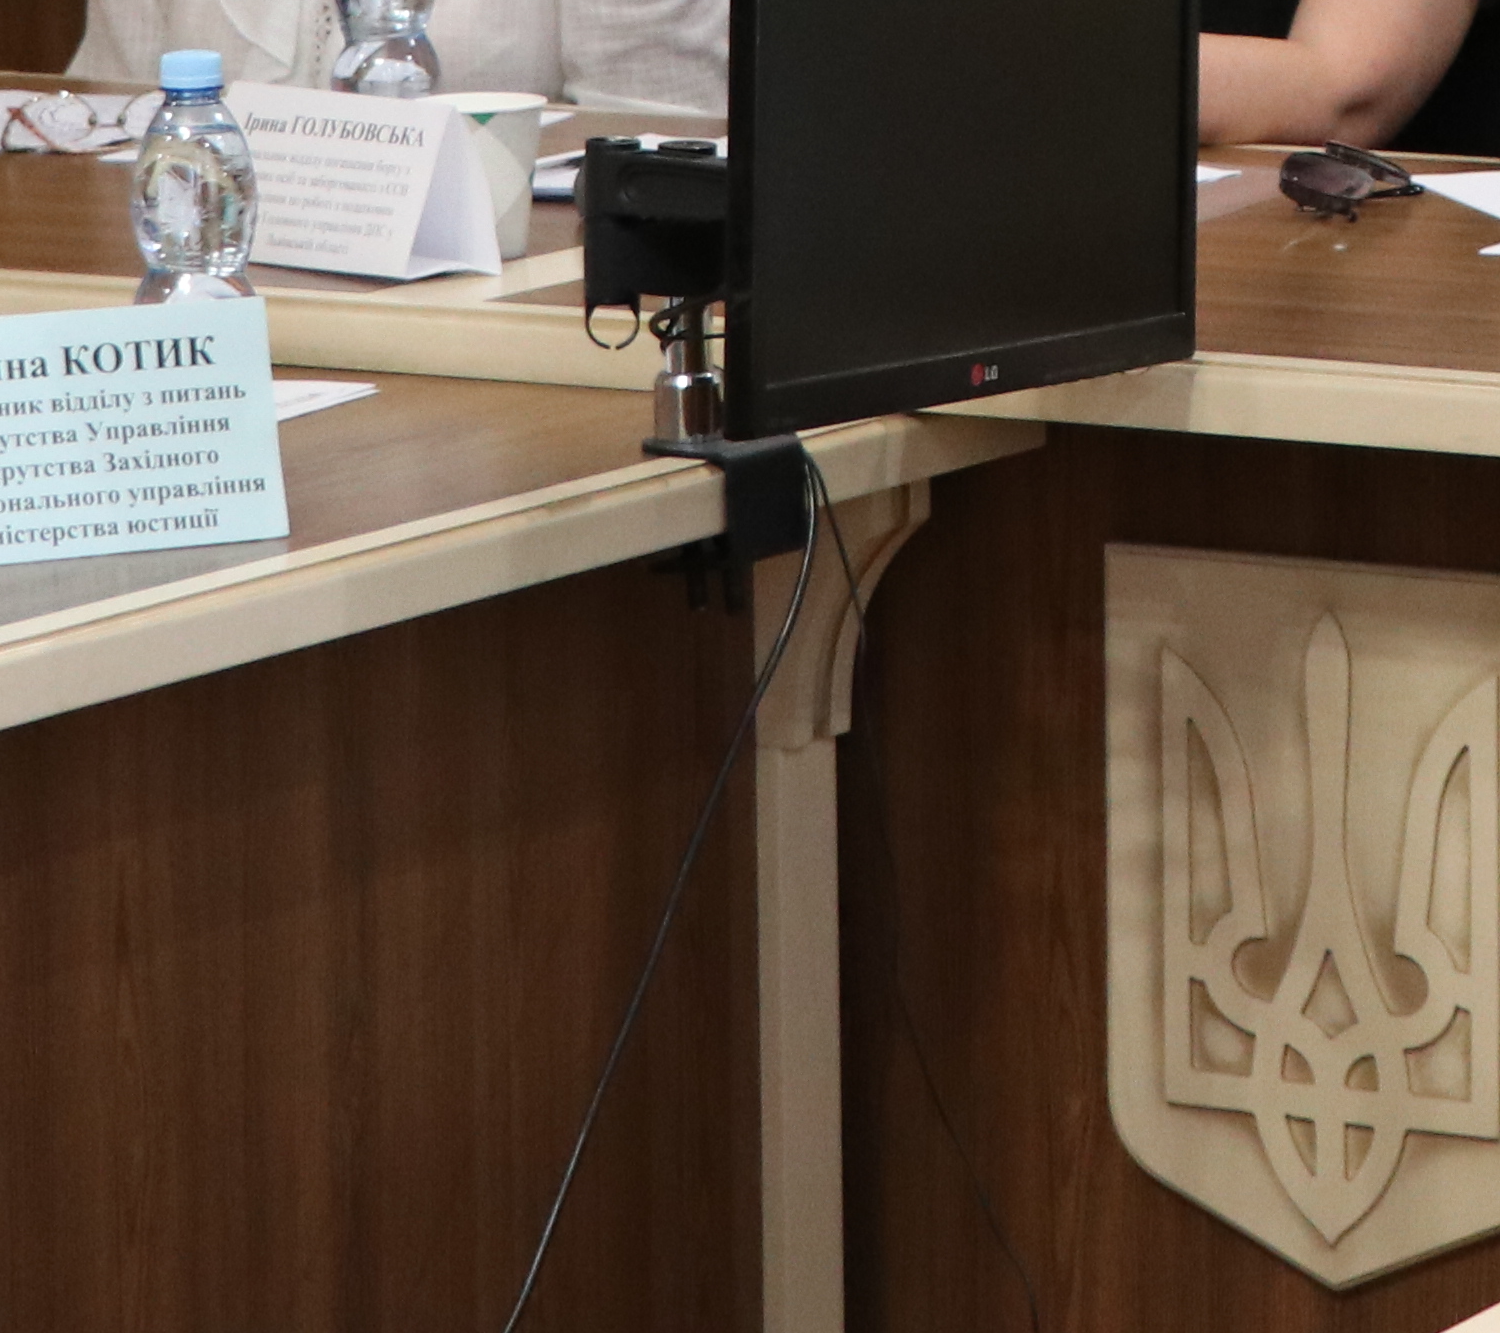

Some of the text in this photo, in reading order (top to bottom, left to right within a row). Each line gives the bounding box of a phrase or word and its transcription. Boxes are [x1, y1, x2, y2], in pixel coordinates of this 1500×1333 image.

[244, 112, 424, 146] Ірина ГОЛУБОВСЬКА
[62, 335, 216, 377] КОТИК
[50, 387, 135, 416] відділу
[143, 391, 153, 406] з
[162, 384, 246, 405] питань
[87, 416, 230, 447] Управління
[103, 447, 219, 474] Західного
[129, 475, 266, 508] управління
[128, 508, 218, 535] юстиції
